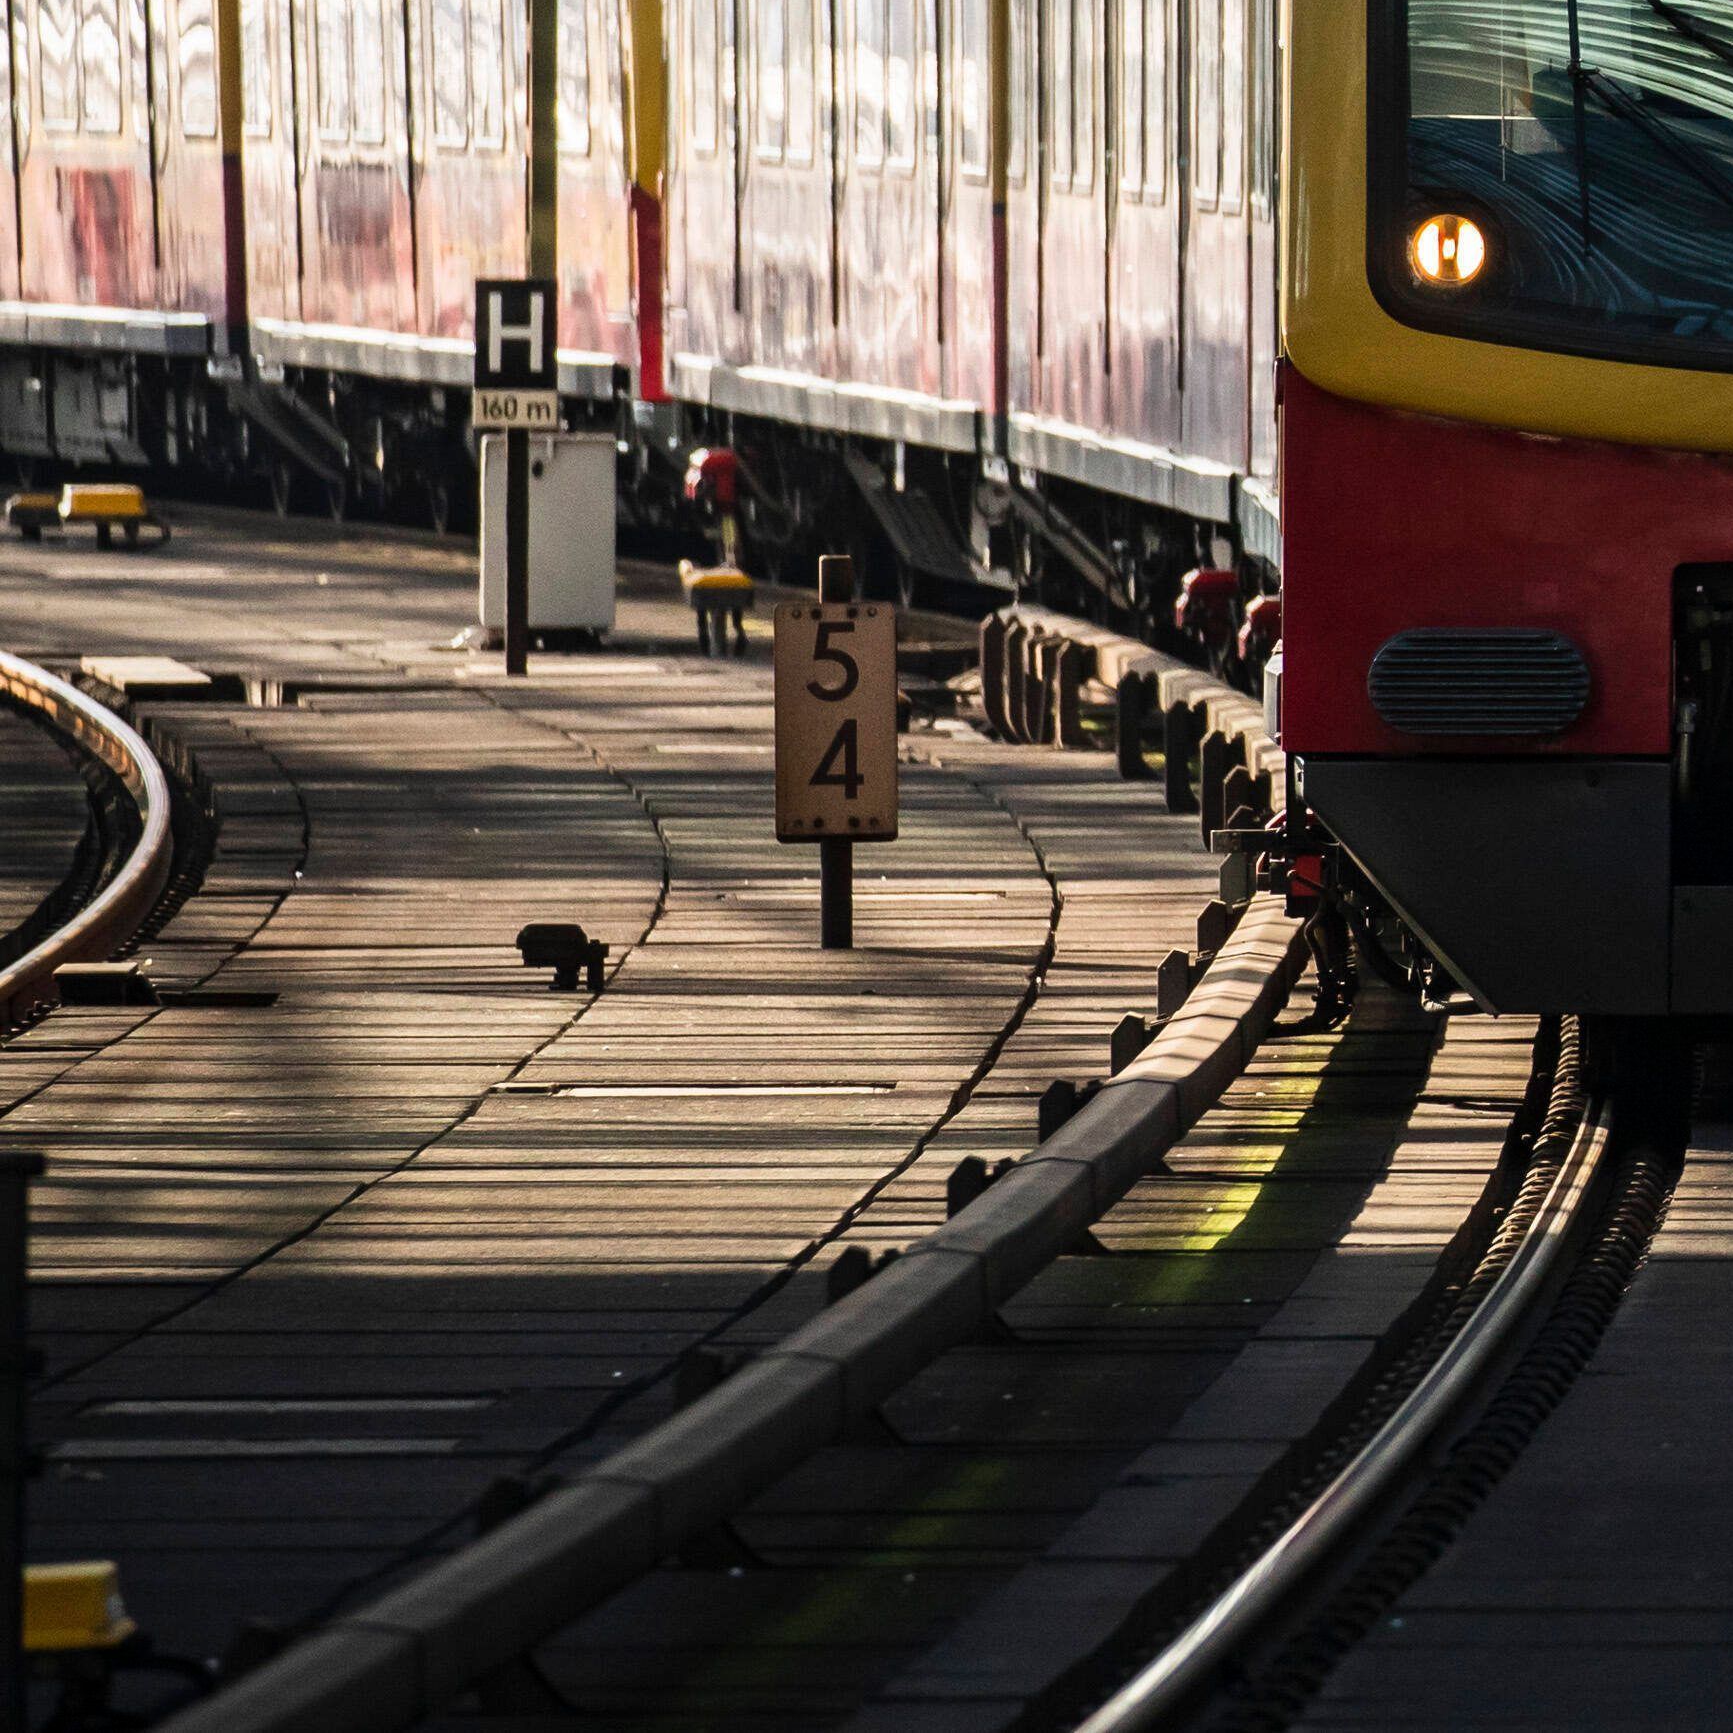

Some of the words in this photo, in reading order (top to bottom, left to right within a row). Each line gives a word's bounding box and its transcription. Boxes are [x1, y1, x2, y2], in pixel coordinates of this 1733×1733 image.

[487, 291, 544, 374] H
[480, 393, 518, 421] 160
[524, 400, 552, 421] m
[806, 621, 860, 702] 5
[809, 718, 865, 800] 4
